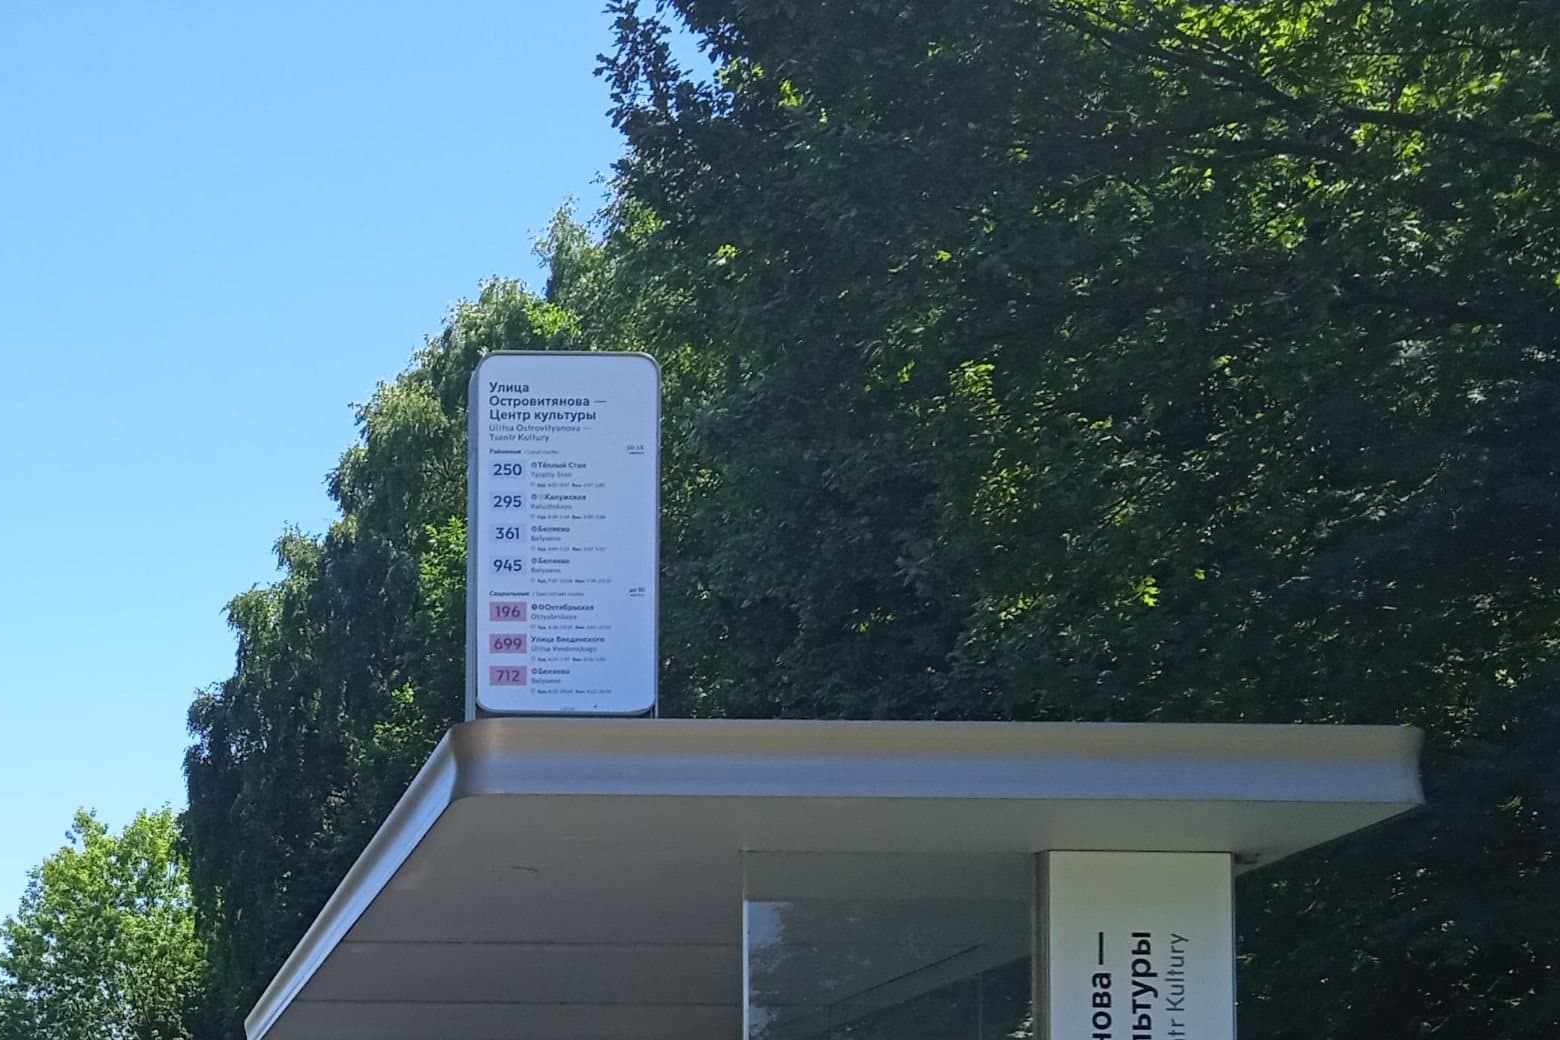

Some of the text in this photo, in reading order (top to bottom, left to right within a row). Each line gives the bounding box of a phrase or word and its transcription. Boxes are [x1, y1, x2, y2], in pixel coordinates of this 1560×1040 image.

[490, 381, 530, 394] Улица
[489, 395, 590, 409] Островитянова
[489, 409, 597, 423] Центр культуры
[489, 423, 514, 432] Ulitsa
[516, 423, 580, 433] Ostrovityanova
[489, 433, 550, 443] Tsentr Kultury
[493, 463, 522, 476] 250
[493, 495, 522, 508] 295
[495, 527, 520, 540] 361
[493, 559, 522, 572] 945
[495, 605, 521, 618] 196
[494, 637, 522, 650] 699
[497, 669, 520, 682] 712
[1164, 933, 1189, 1012] Kultury
